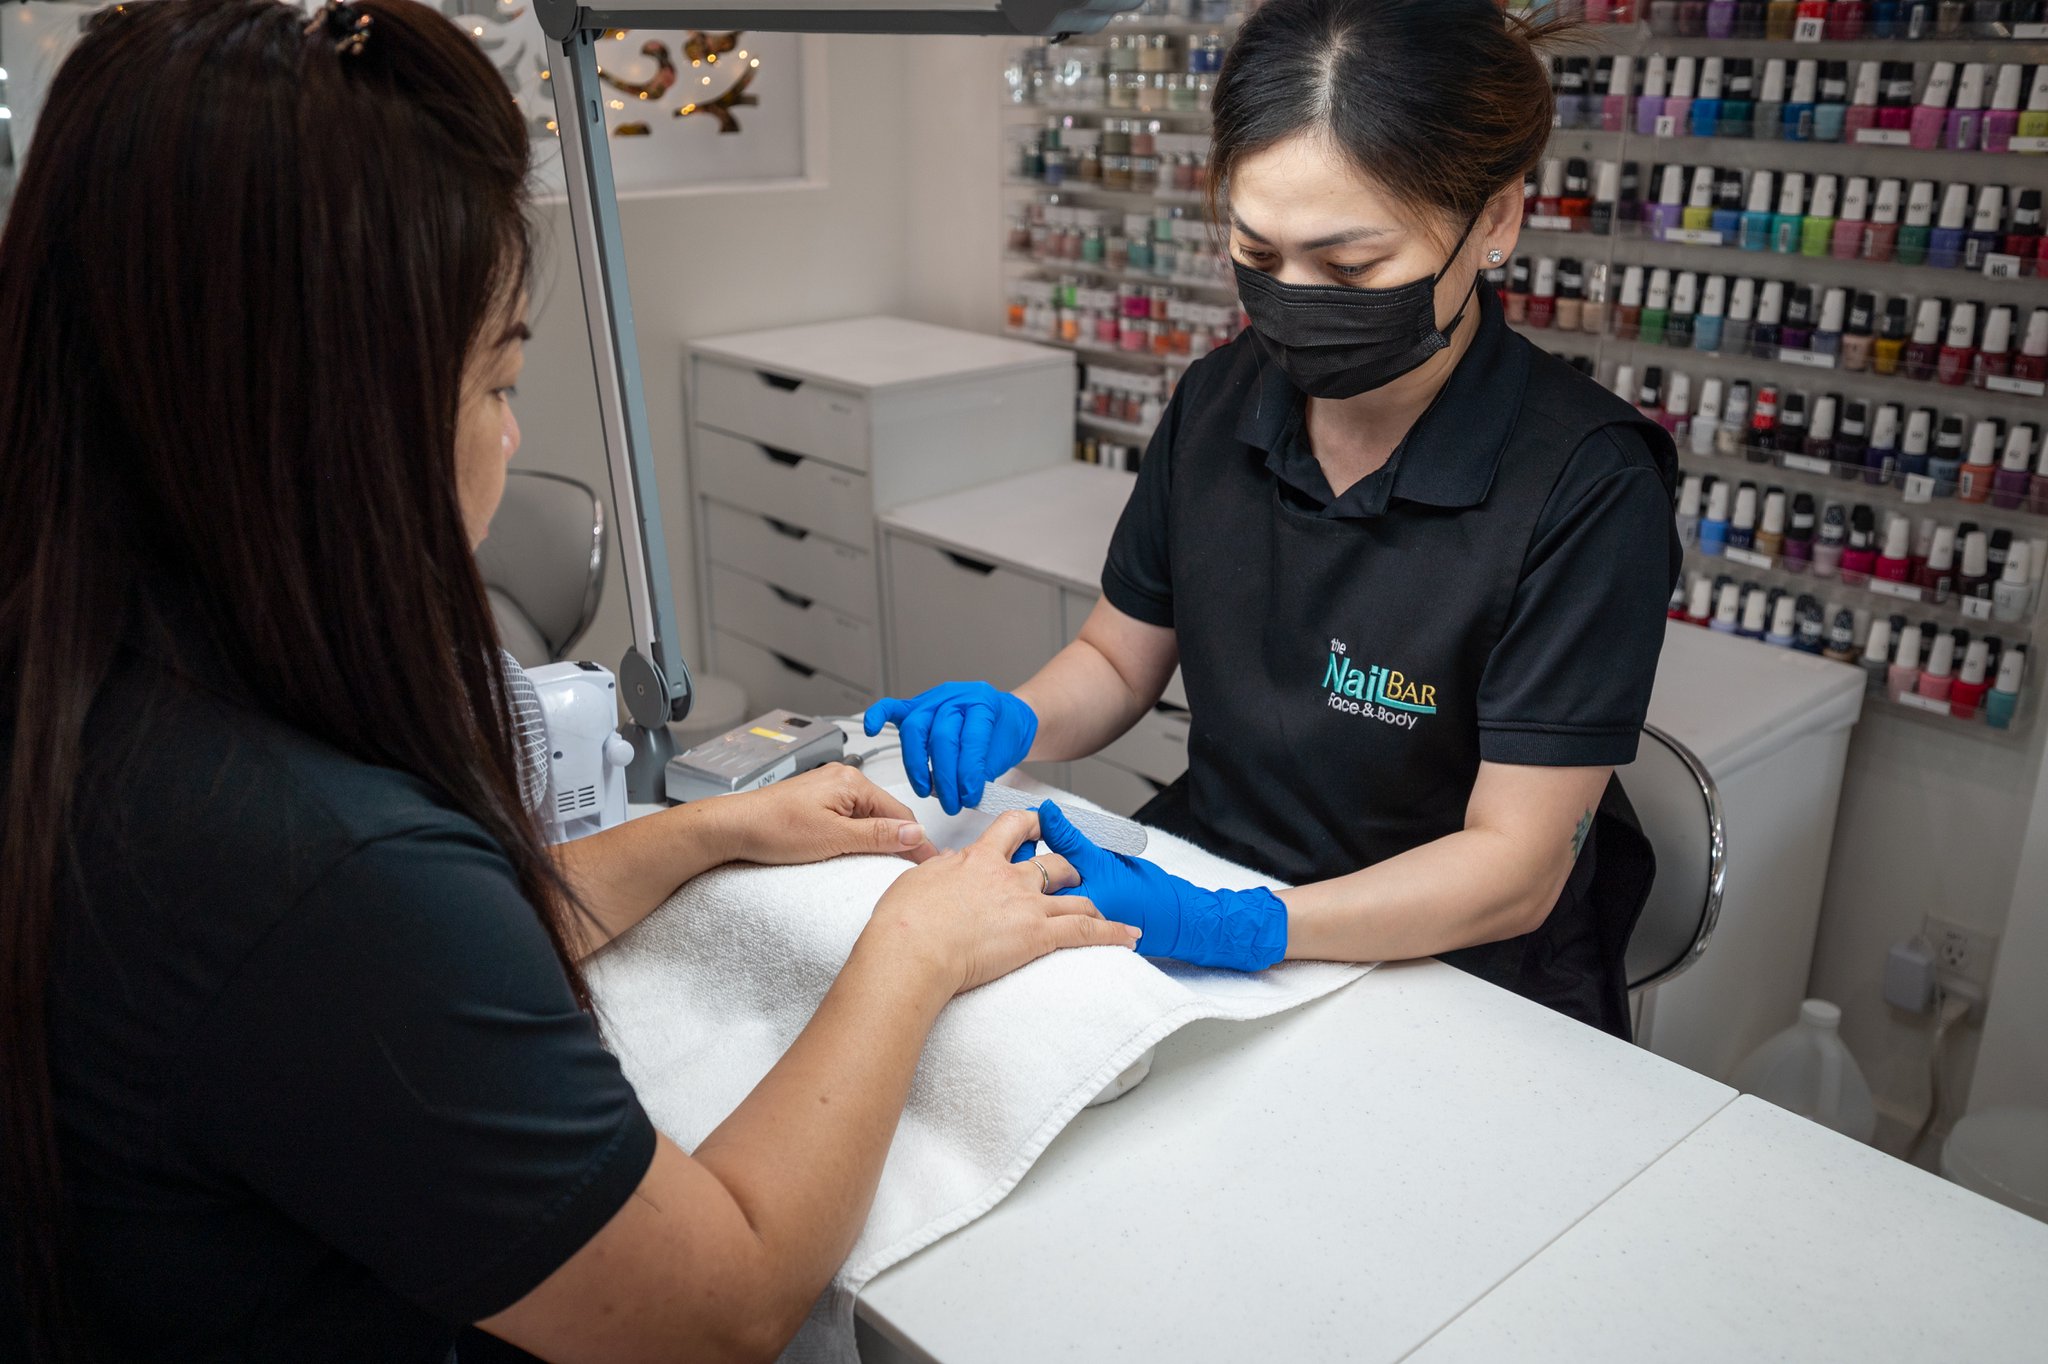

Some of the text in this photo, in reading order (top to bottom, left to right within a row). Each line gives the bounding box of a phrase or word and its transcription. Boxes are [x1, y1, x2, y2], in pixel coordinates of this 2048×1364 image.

[1331, 638, 1347, 654] the
[1361, 702, 1375, 718] &
[1377, 706, 1418, 730] Body
